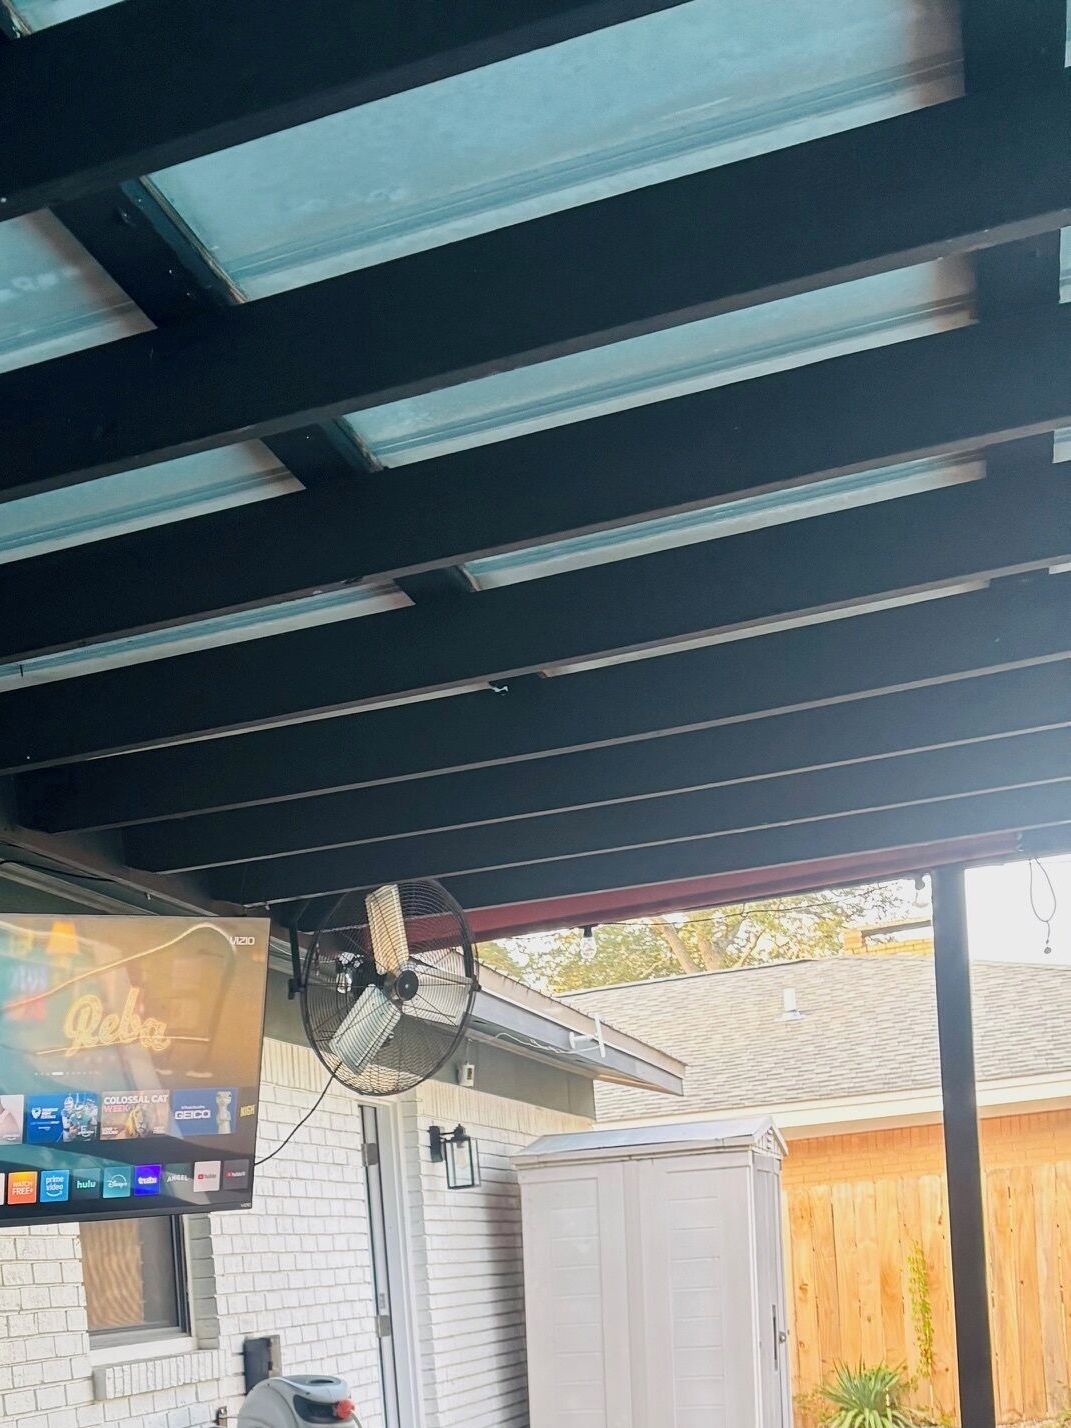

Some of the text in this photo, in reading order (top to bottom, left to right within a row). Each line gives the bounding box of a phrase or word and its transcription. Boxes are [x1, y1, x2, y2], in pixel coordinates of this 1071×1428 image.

[229, 936, 255, 946] VIZIO
[64, 987, 171, 1057] Reba
[104, 1094, 169, 1105] COLOSSAL CAT
[103, 1104, 130, 1113] WEEK
[174, 1109, 212, 1120] GEICO
[46, 1176, 65, 1185] prime
[166, 1173, 190, 1183] ANGEL
[12, 1181, 34, 1189] WATCH
[46, 1183, 64, 1191] video
[76, 1180, 97, 1189] hulu
[12, 1187, 34, 1196] FREE+
